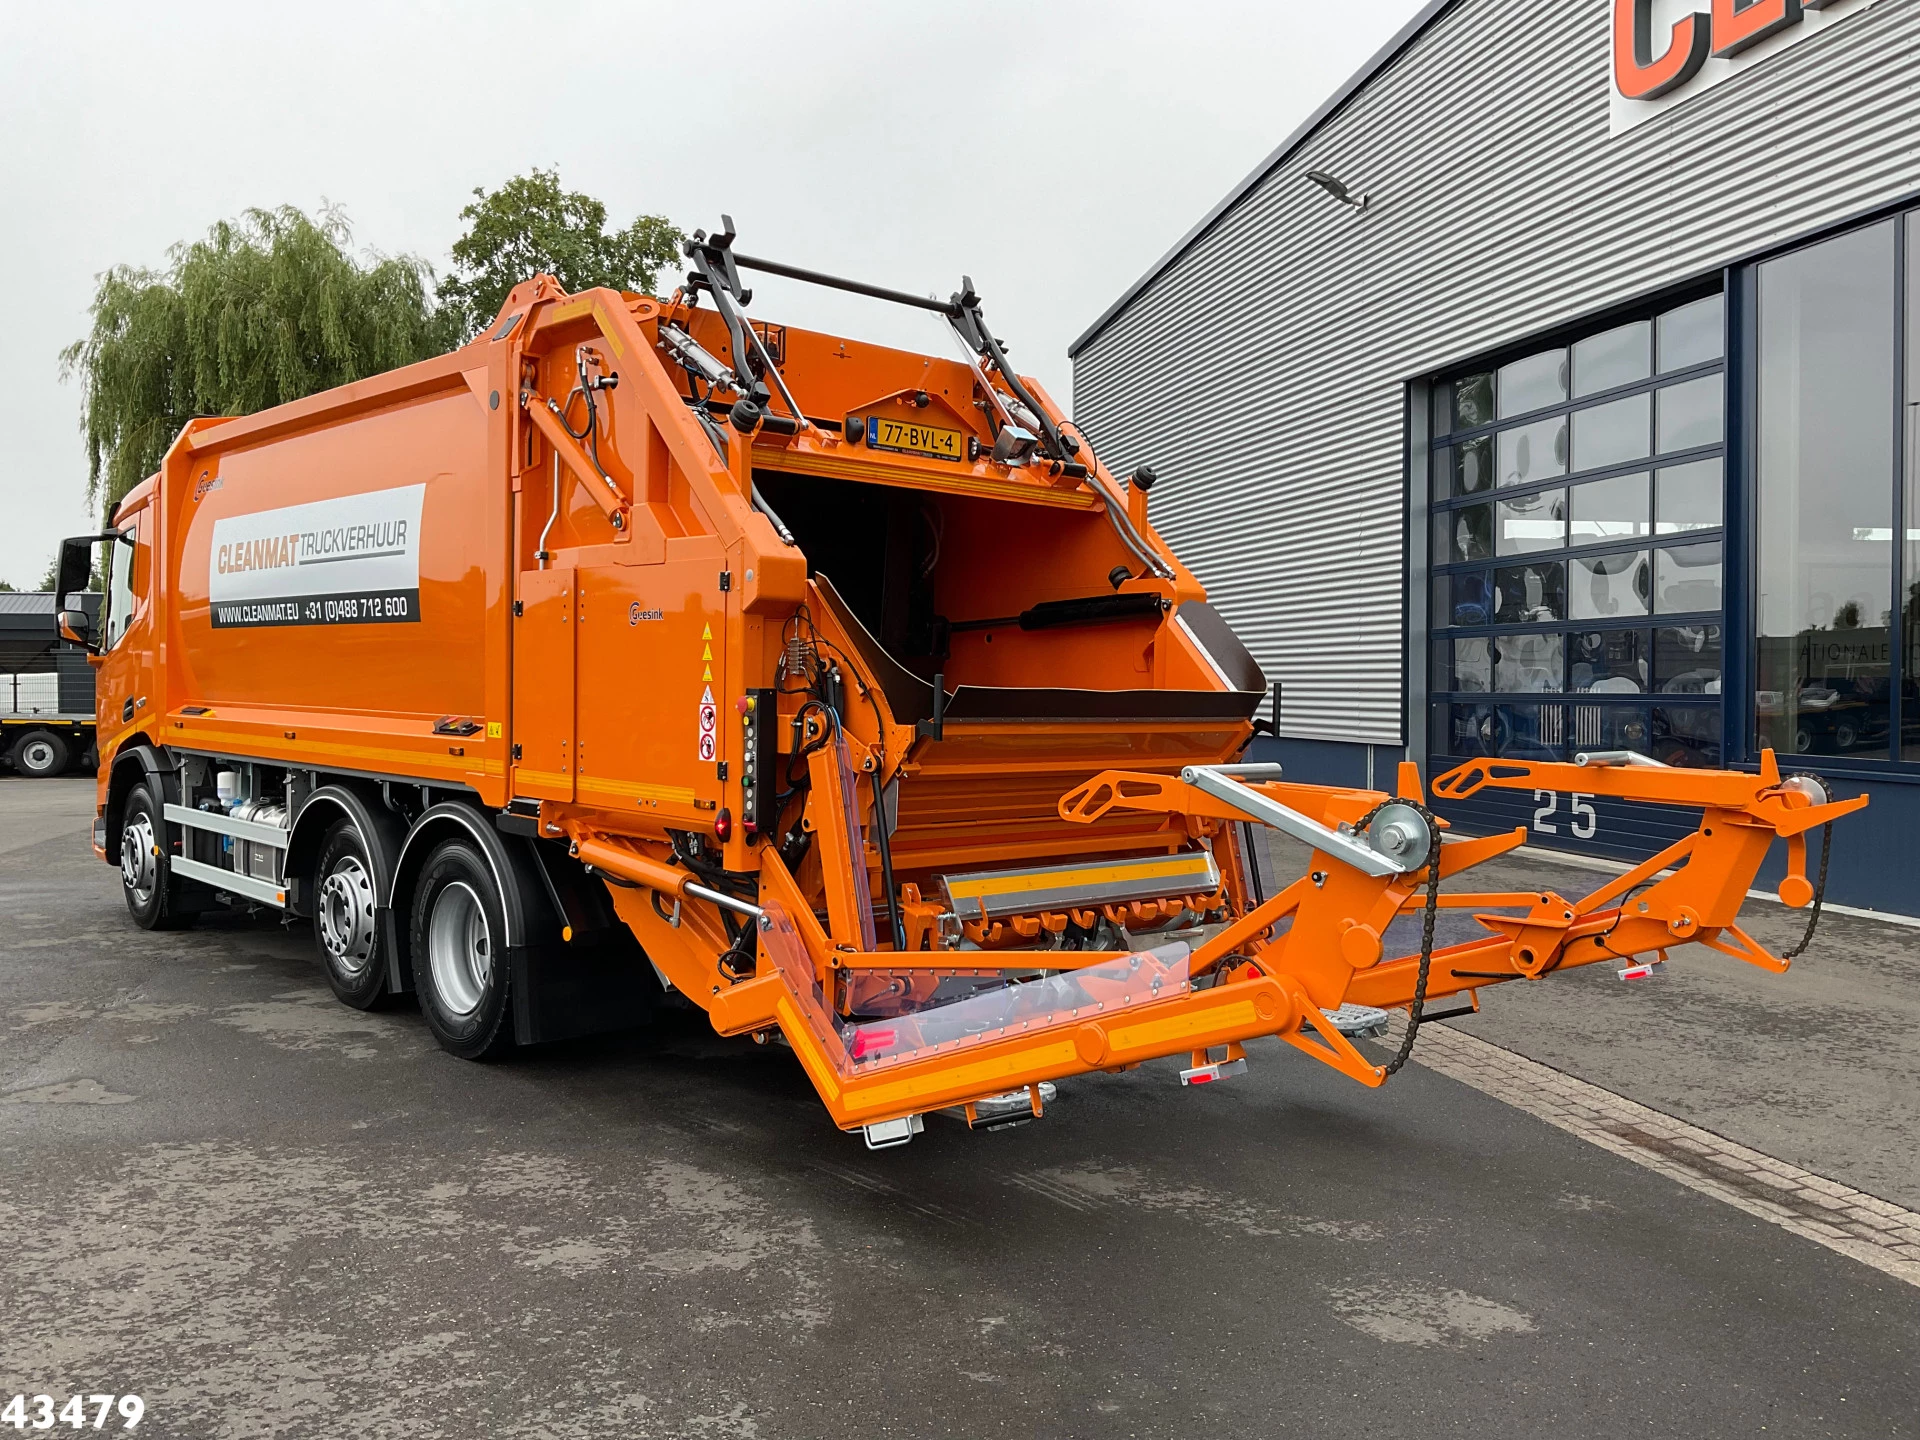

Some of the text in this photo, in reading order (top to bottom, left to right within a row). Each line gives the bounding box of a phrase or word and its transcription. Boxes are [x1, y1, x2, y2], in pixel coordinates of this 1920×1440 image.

[869, 432, 877, 440] NL
[884, 423, 953, 452] 77-BVL-4
[218, 519, 407, 574] CLEANMAT TRUCKVERHUUR
[218, 596, 408, 624] WWW.CLEANMAT.EU +31 (0)488 712 600
[631, 606, 664, 622] Geesink
[1533, 788, 1596, 839] 25
